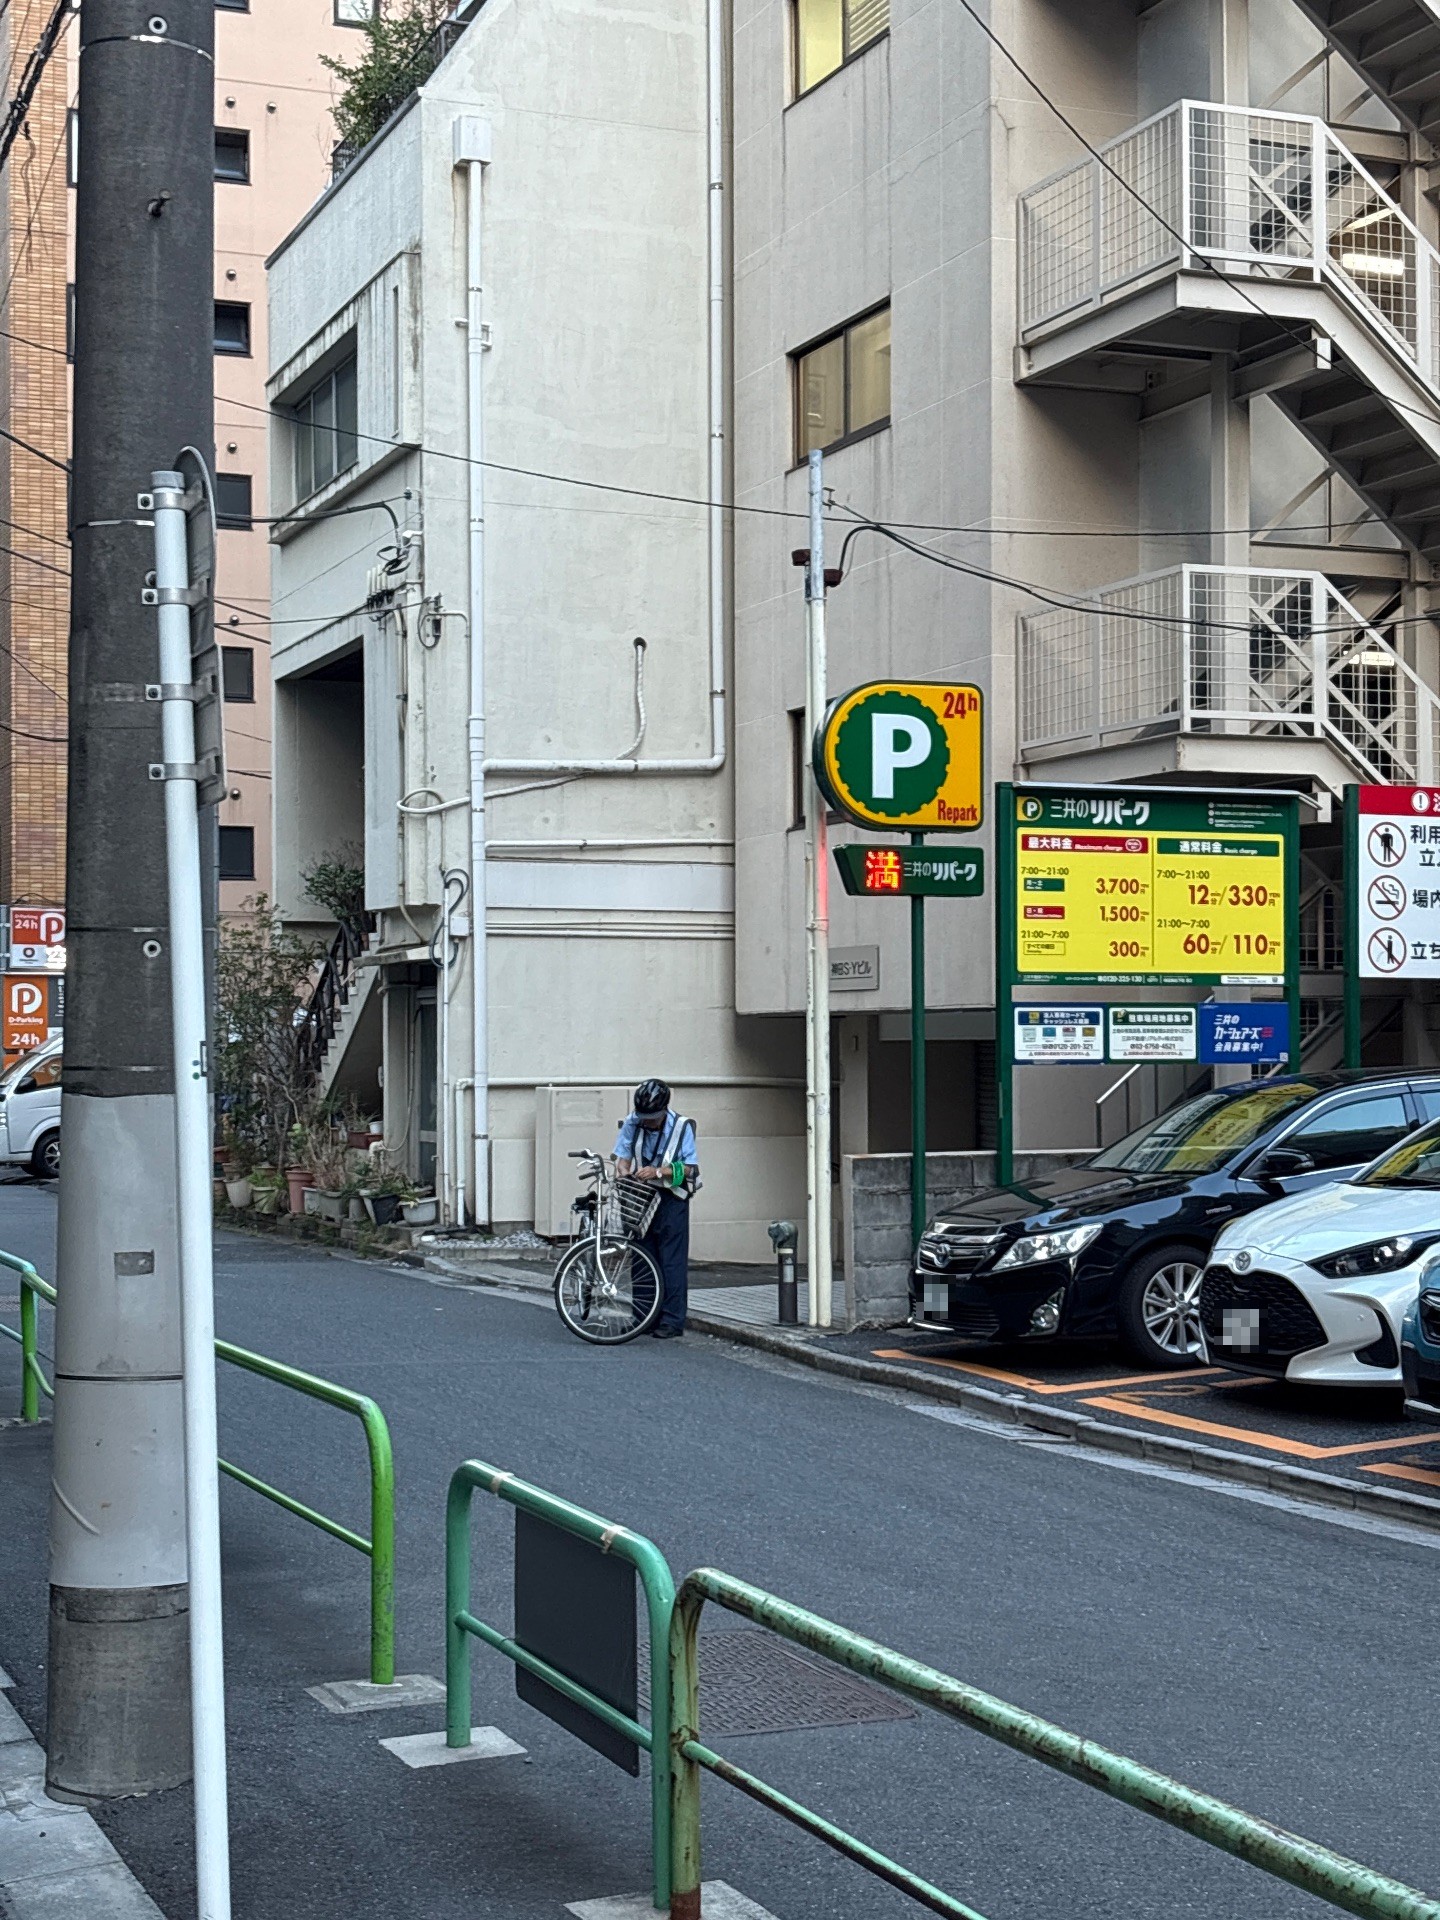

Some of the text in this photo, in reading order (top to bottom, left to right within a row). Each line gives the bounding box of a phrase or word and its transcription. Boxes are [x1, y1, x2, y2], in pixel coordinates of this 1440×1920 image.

[943, 692, 977, 719] 24h
[872, 713, 931, 799] P
[937, 799, 978, 823] Repark
[1050, 797, 1150, 826] 三井のリパーク
[1028, 836, 1072, 850] 最大料金
[1179, 841, 1222, 853] 通常料金
[866, 850, 900, 889] 満
[904, 860, 977, 882] 三井のリパーク
[1095, 877, 1140, 895] 3,700
[1228, 884, 1268, 906] 330
[1099, 905, 1140, 923] 1,500
[14, 919, 39, 930] 24h
[1108, 940, 1140, 958] 300
[1183, 932, 1210, 955] 60
[1233, 934, 1268, 956] 110
[8, 1016, 44, 1025] D-Parking
[1213, 1014, 1241, 1025] 三井の
[11, 1032, 41, 1046] 24h
